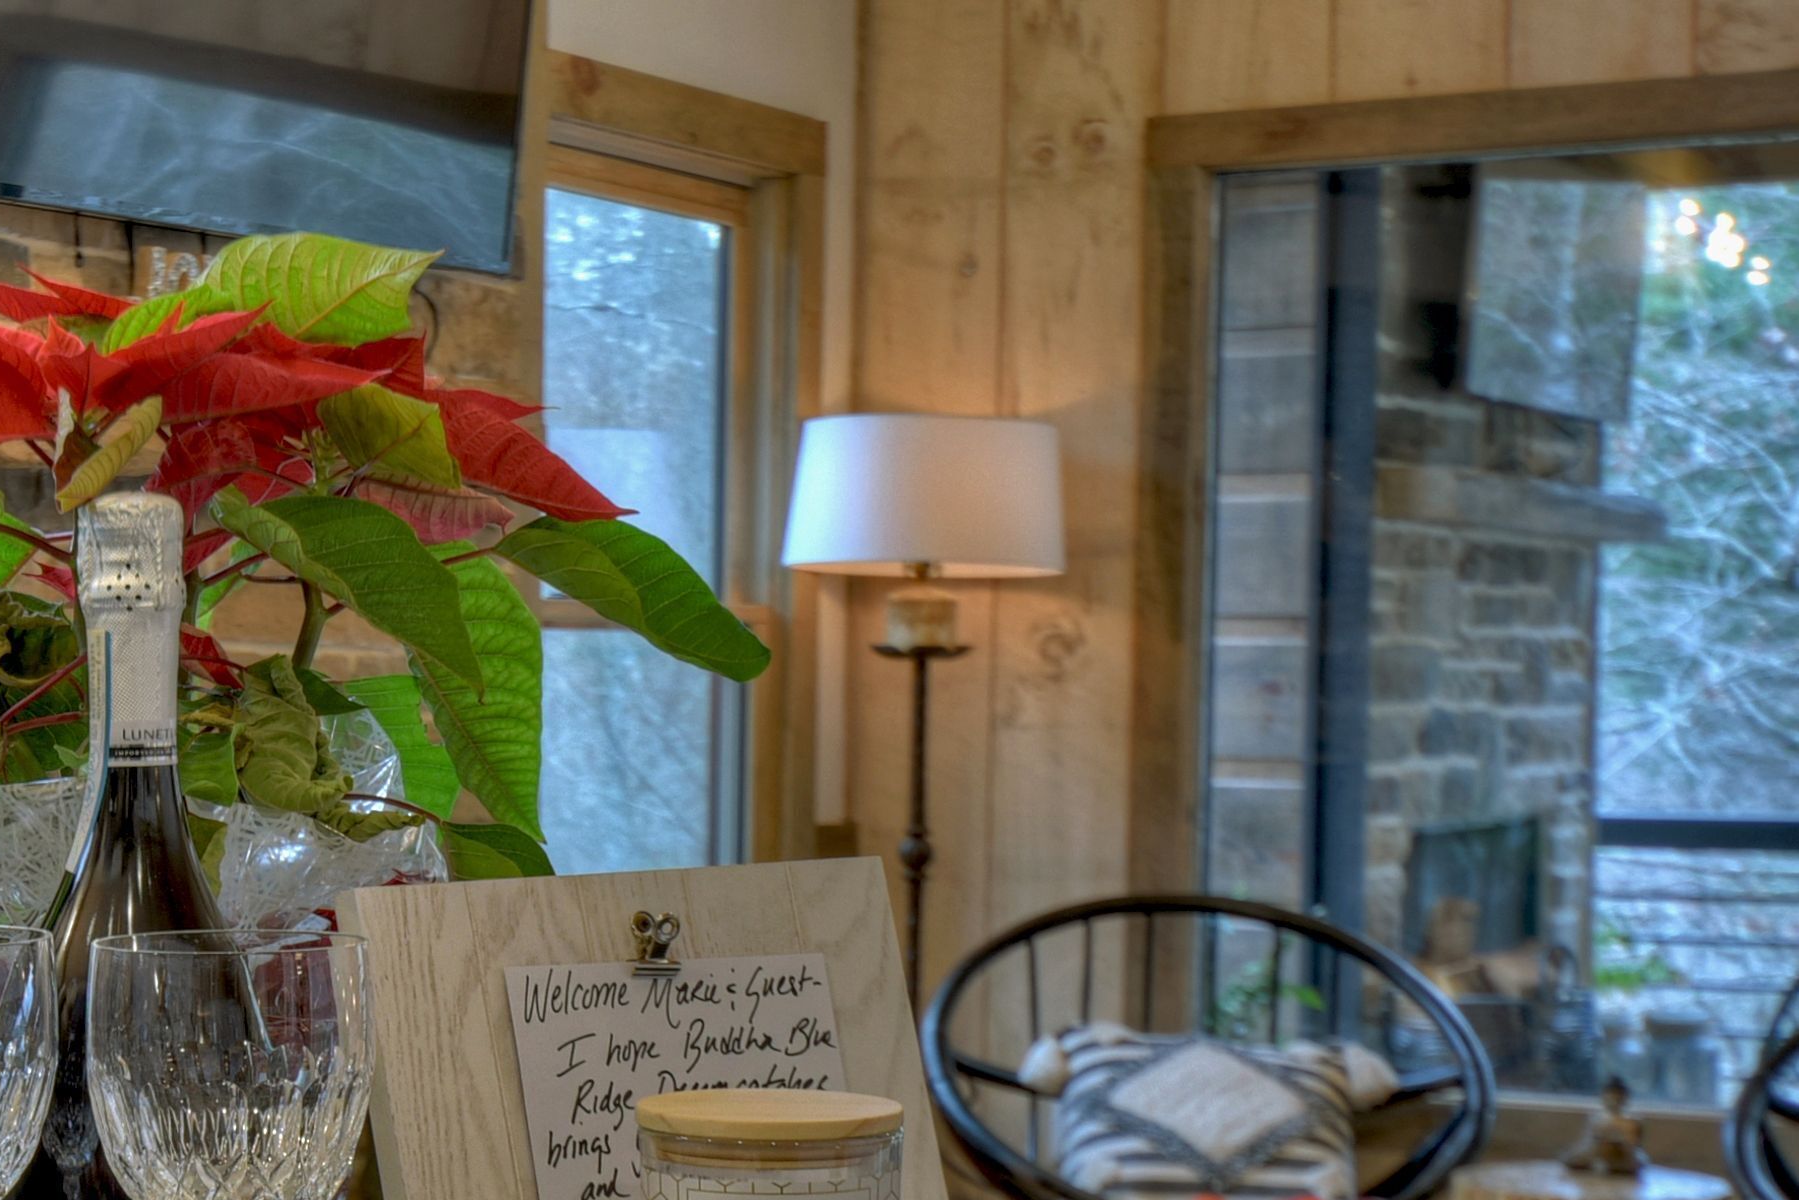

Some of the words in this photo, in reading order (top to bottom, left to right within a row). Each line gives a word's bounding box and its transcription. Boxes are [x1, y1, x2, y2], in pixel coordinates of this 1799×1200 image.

[524, 968, 630, 1024] Welcome
[556, 1032, 596, 1077] I
[606, 1033, 661, 1073] hope
[683, 1018, 782, 1074] Buddha
[784, 1017, 838, 1057] Blue
[571, 1079, 635, 1131] Ridge
[548, 1131, 611, 1174] brings
